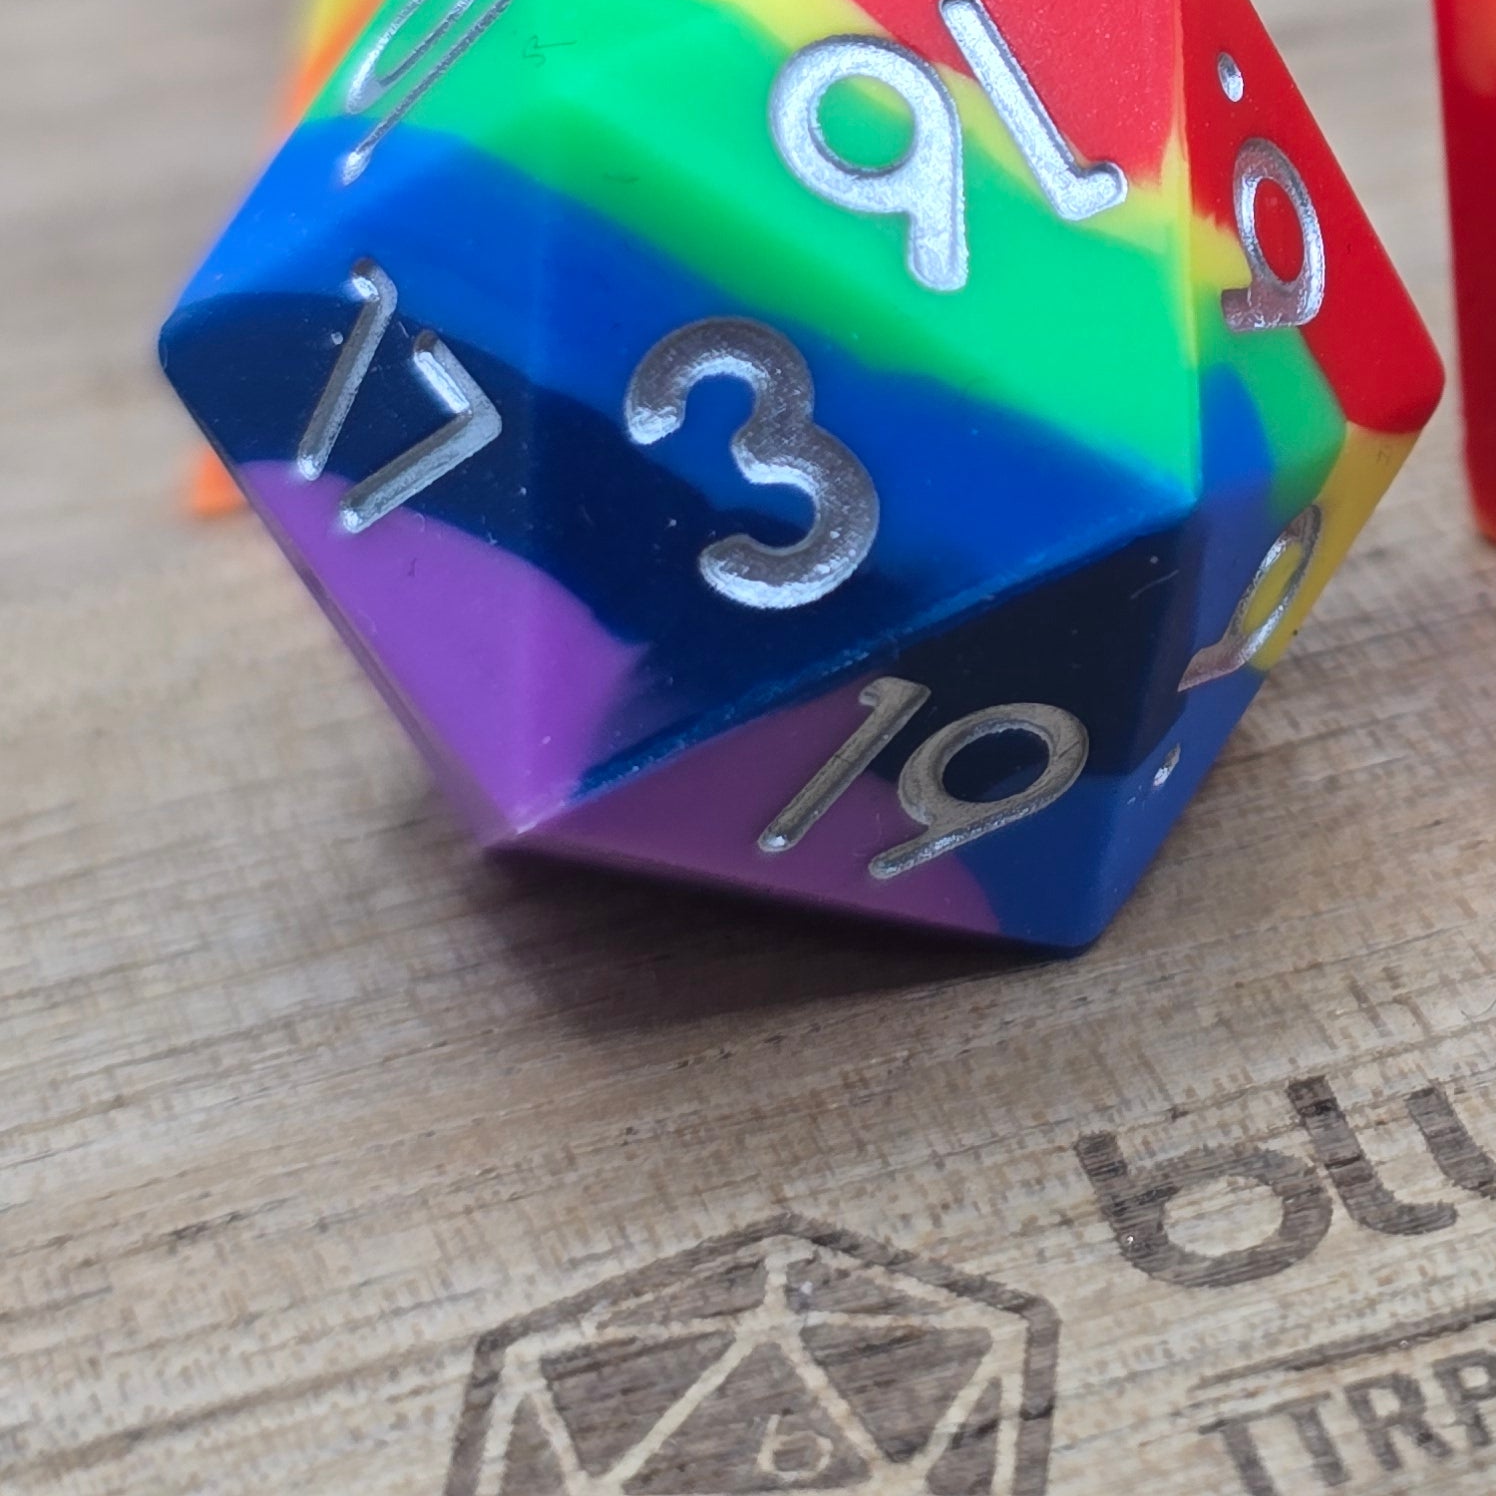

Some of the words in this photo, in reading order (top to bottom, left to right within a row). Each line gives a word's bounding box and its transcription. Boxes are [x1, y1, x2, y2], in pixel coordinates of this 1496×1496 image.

[296, 256, 503, 534] 17
[625, 317, 882, 610] 3
[757, 675, 1090, 880] 19
